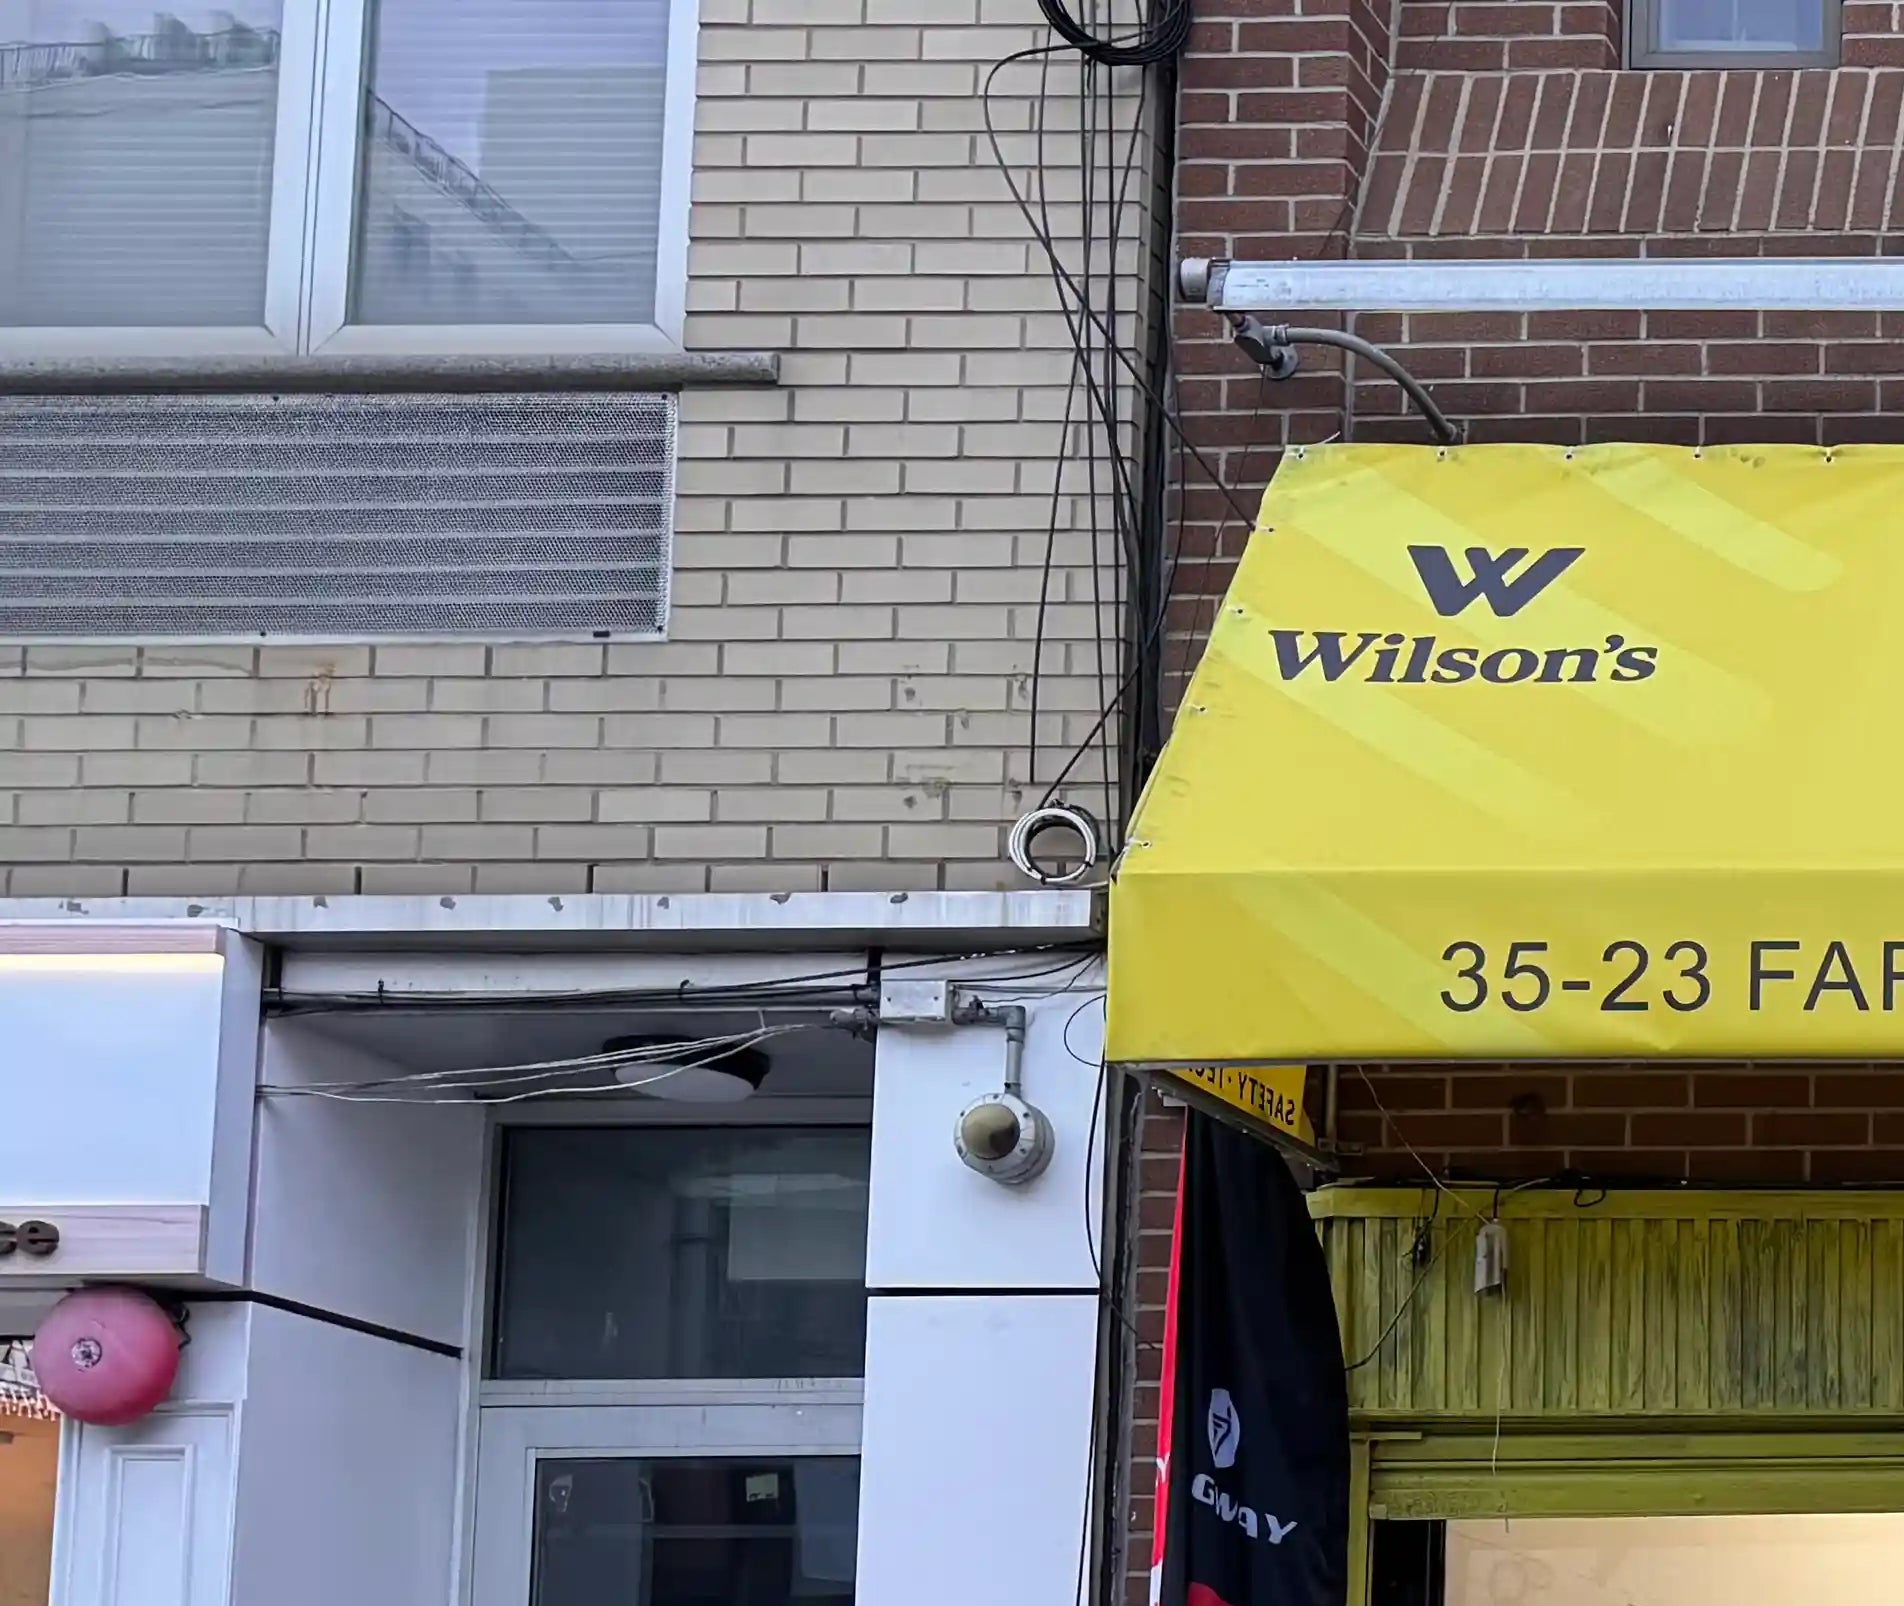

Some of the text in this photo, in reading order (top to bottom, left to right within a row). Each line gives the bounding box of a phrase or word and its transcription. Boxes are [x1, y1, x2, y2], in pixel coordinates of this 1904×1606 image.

[1268, 630, 1657, 685] Wilson's
[1441, 941, 1710, 1012] 35-23
[1191, 1473, 1298, 1545] GWAY
